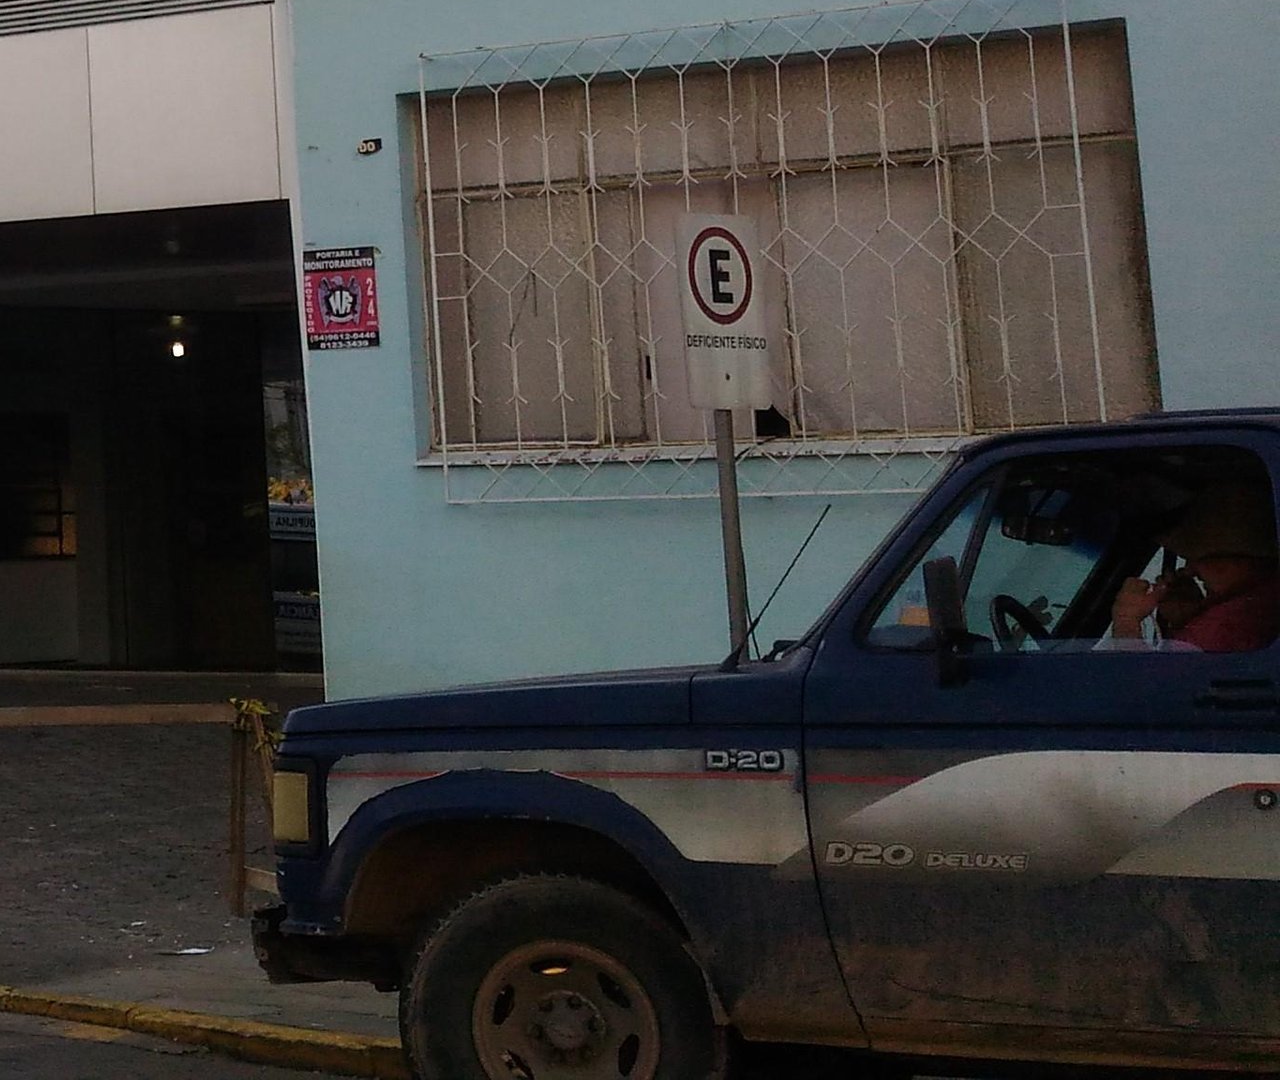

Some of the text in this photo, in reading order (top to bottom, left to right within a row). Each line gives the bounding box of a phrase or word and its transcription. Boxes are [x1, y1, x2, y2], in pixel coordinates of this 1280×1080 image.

[316, 251, 353, 259] PORTARIA
[304, 258, 373, 270] MONITORAMENTO
[709, 249, 733, 304] E
[687, 333, 767, 349] DEFICIENTE FÍSICO
[827, 842, 1028, 870] D20 DELUXE
